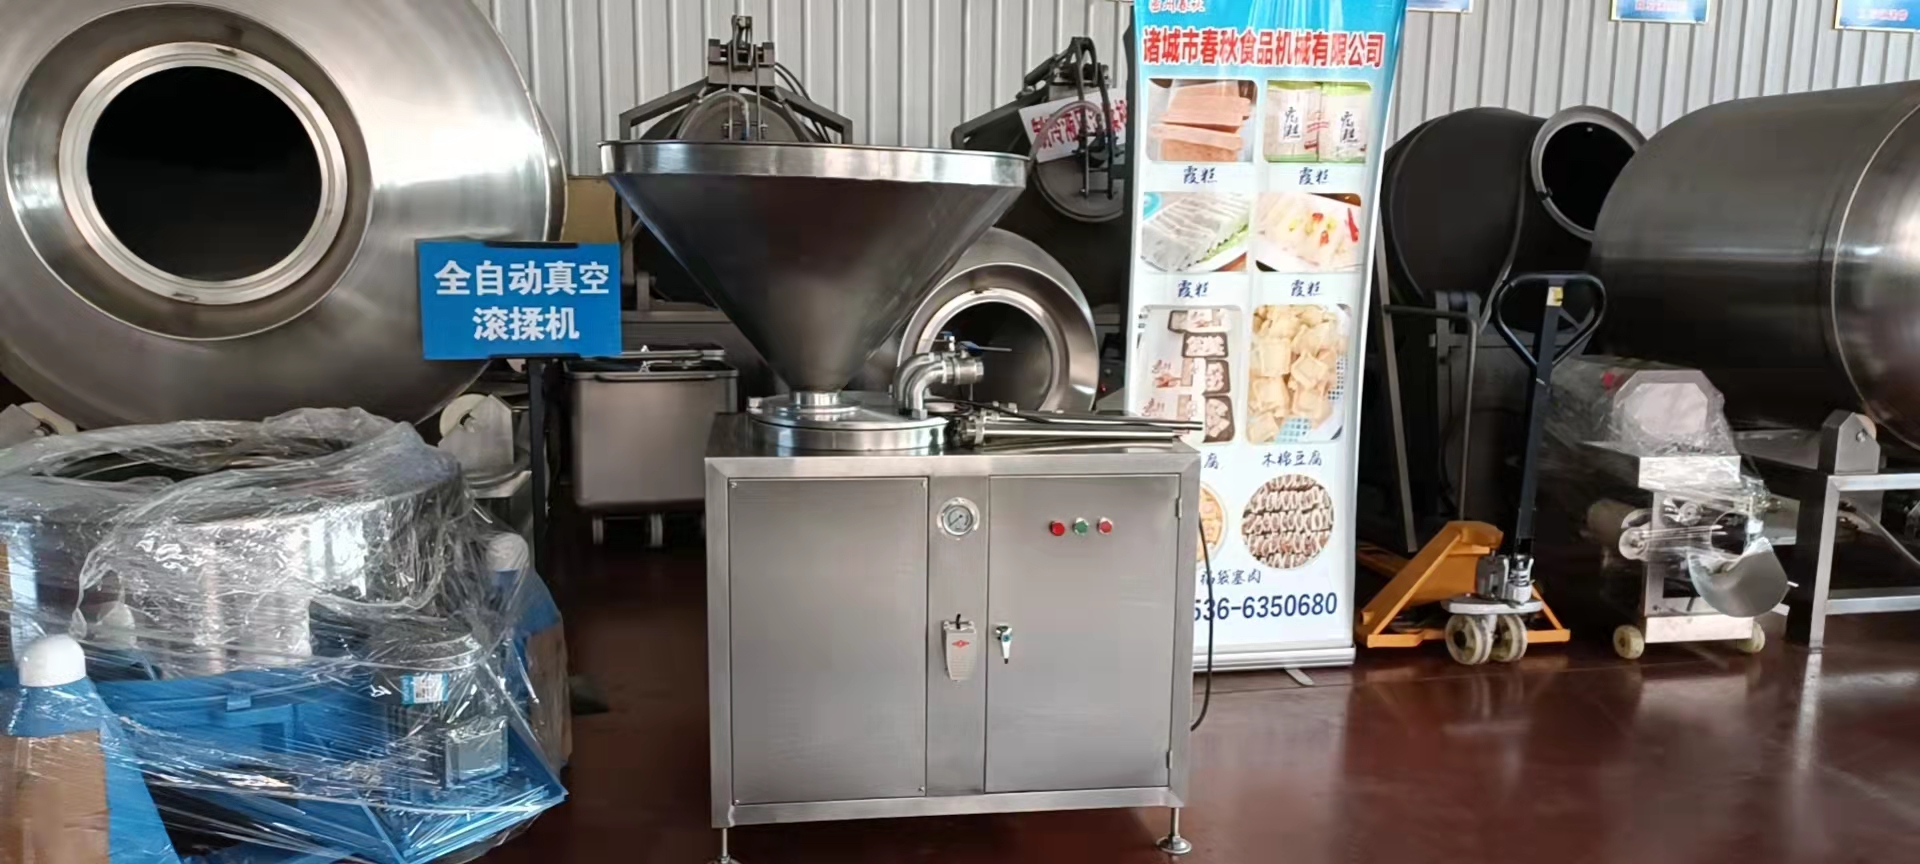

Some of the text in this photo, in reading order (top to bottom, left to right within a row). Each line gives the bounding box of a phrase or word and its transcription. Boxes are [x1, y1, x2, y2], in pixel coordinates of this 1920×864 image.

[1143, 27, 1384, 67] 诸城市春秋食品机械有限公司
[434, 259, 609, 296] 全自动真空
[472, 305, 580, 341] 滚揉机
[1262, 450, 1322, 467] 木棉豆腐
